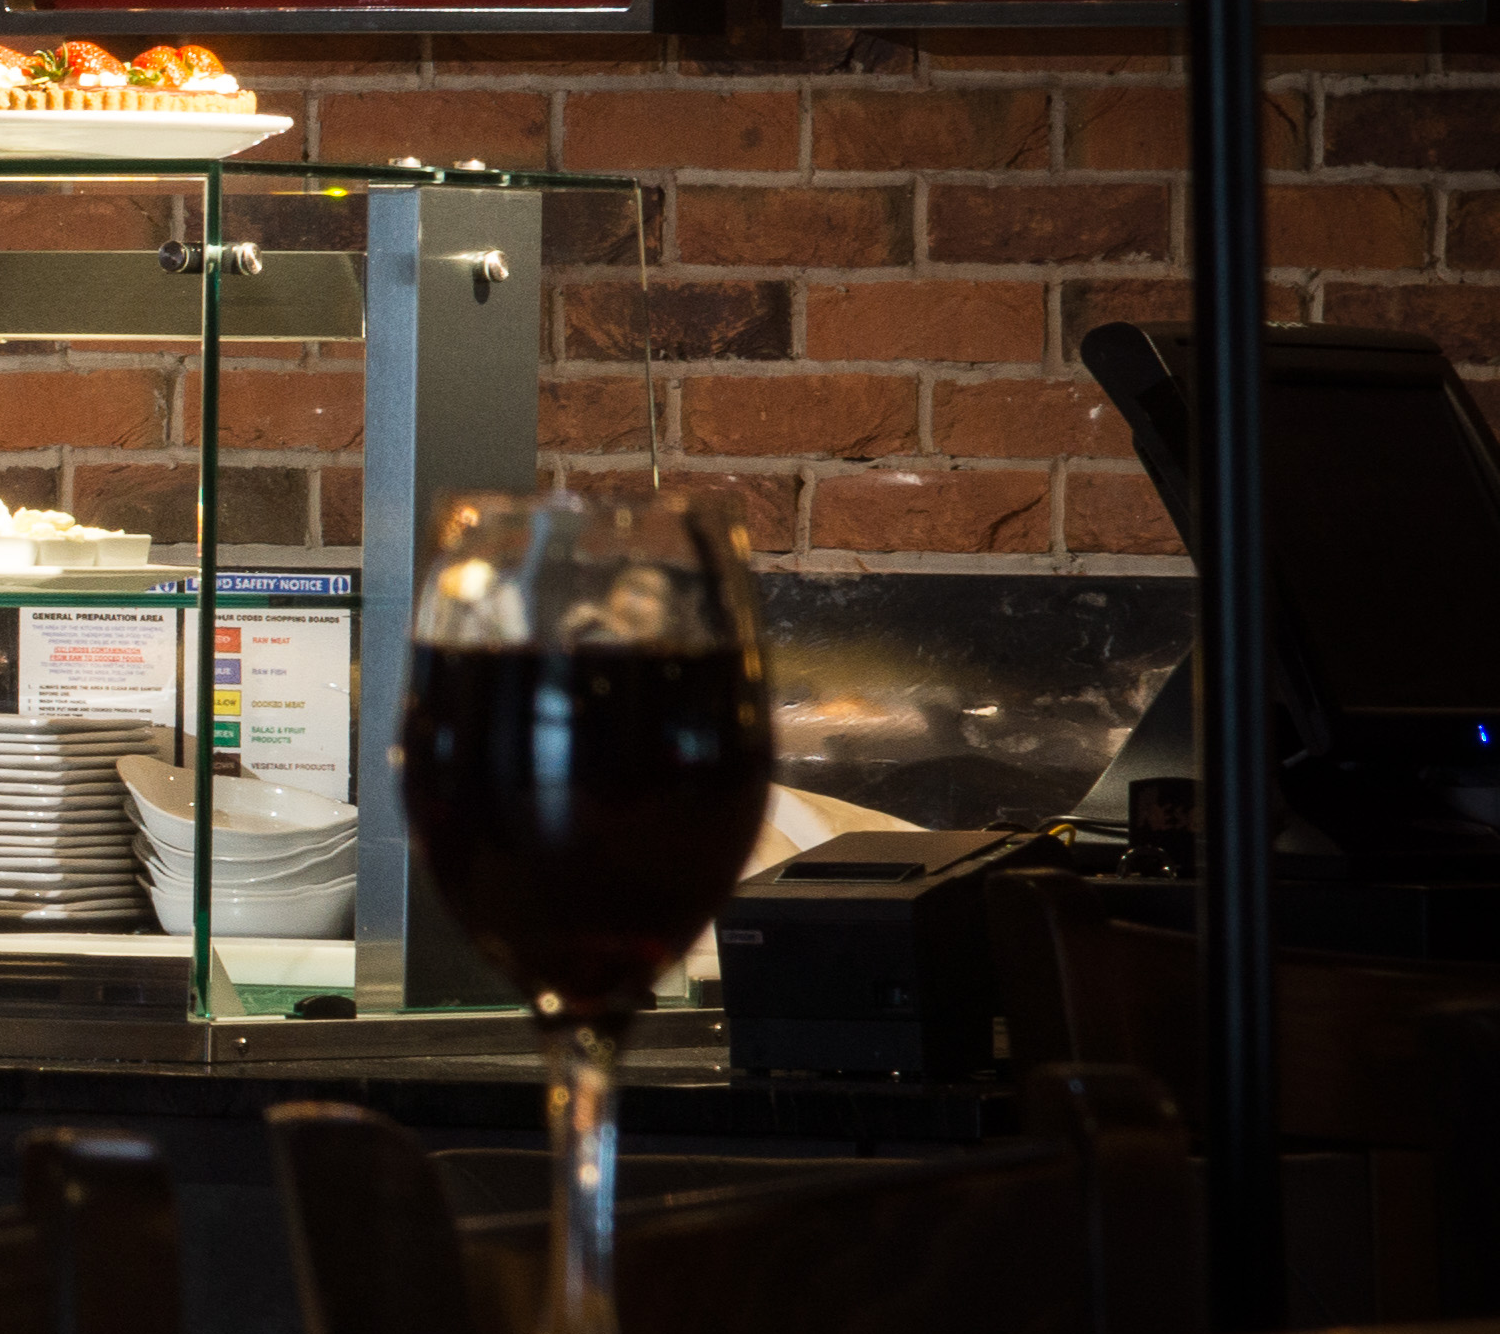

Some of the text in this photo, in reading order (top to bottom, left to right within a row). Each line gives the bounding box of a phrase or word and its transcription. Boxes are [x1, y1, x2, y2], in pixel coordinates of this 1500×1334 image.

[235, 577, 277, 590] SAFETY
[280, 578, 323, 591] NOTICE
[32, 612, 164, 622] GENERAL PREPARATION AREA
